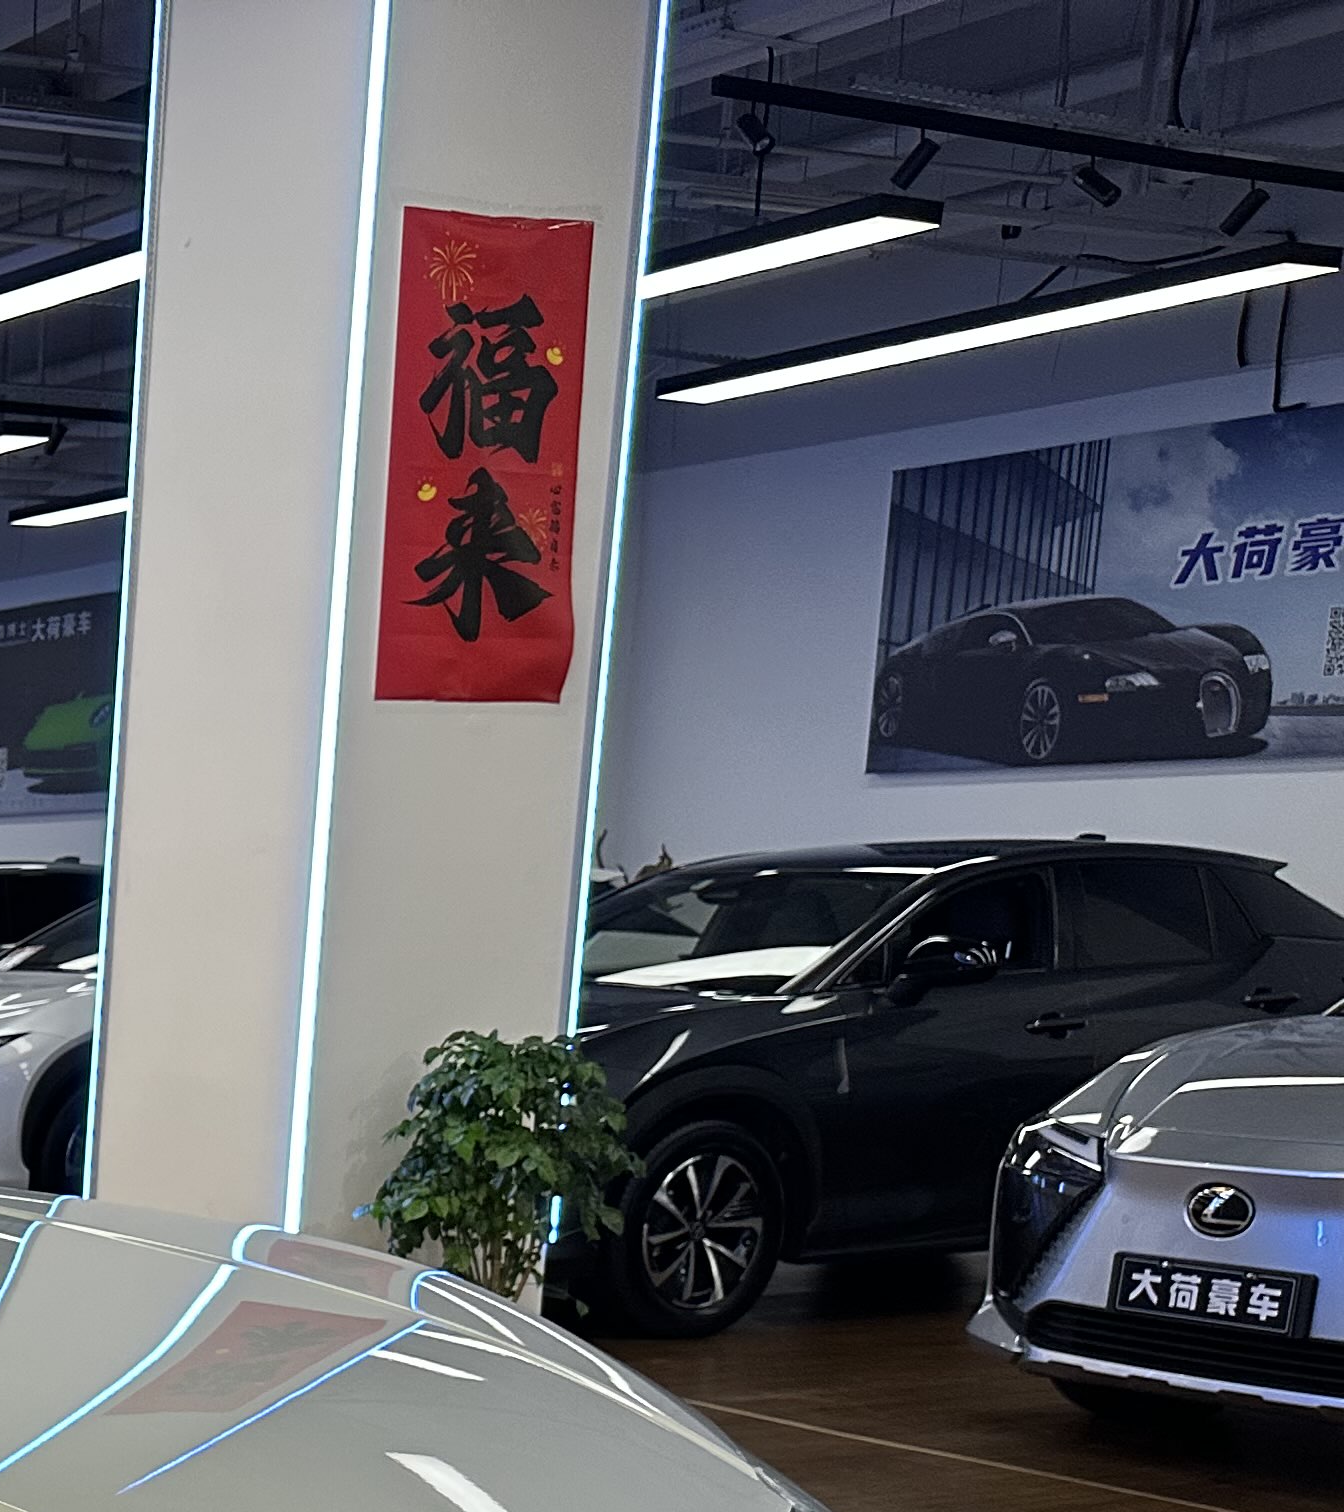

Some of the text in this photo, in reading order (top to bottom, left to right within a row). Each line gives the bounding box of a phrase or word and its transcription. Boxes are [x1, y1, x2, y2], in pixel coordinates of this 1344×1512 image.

[401, 293, 558, 643] 福来
[1173, 516, 1344, 586] 大荷豪
[1127, 1267, 1283, 1322] 大荷豪车
